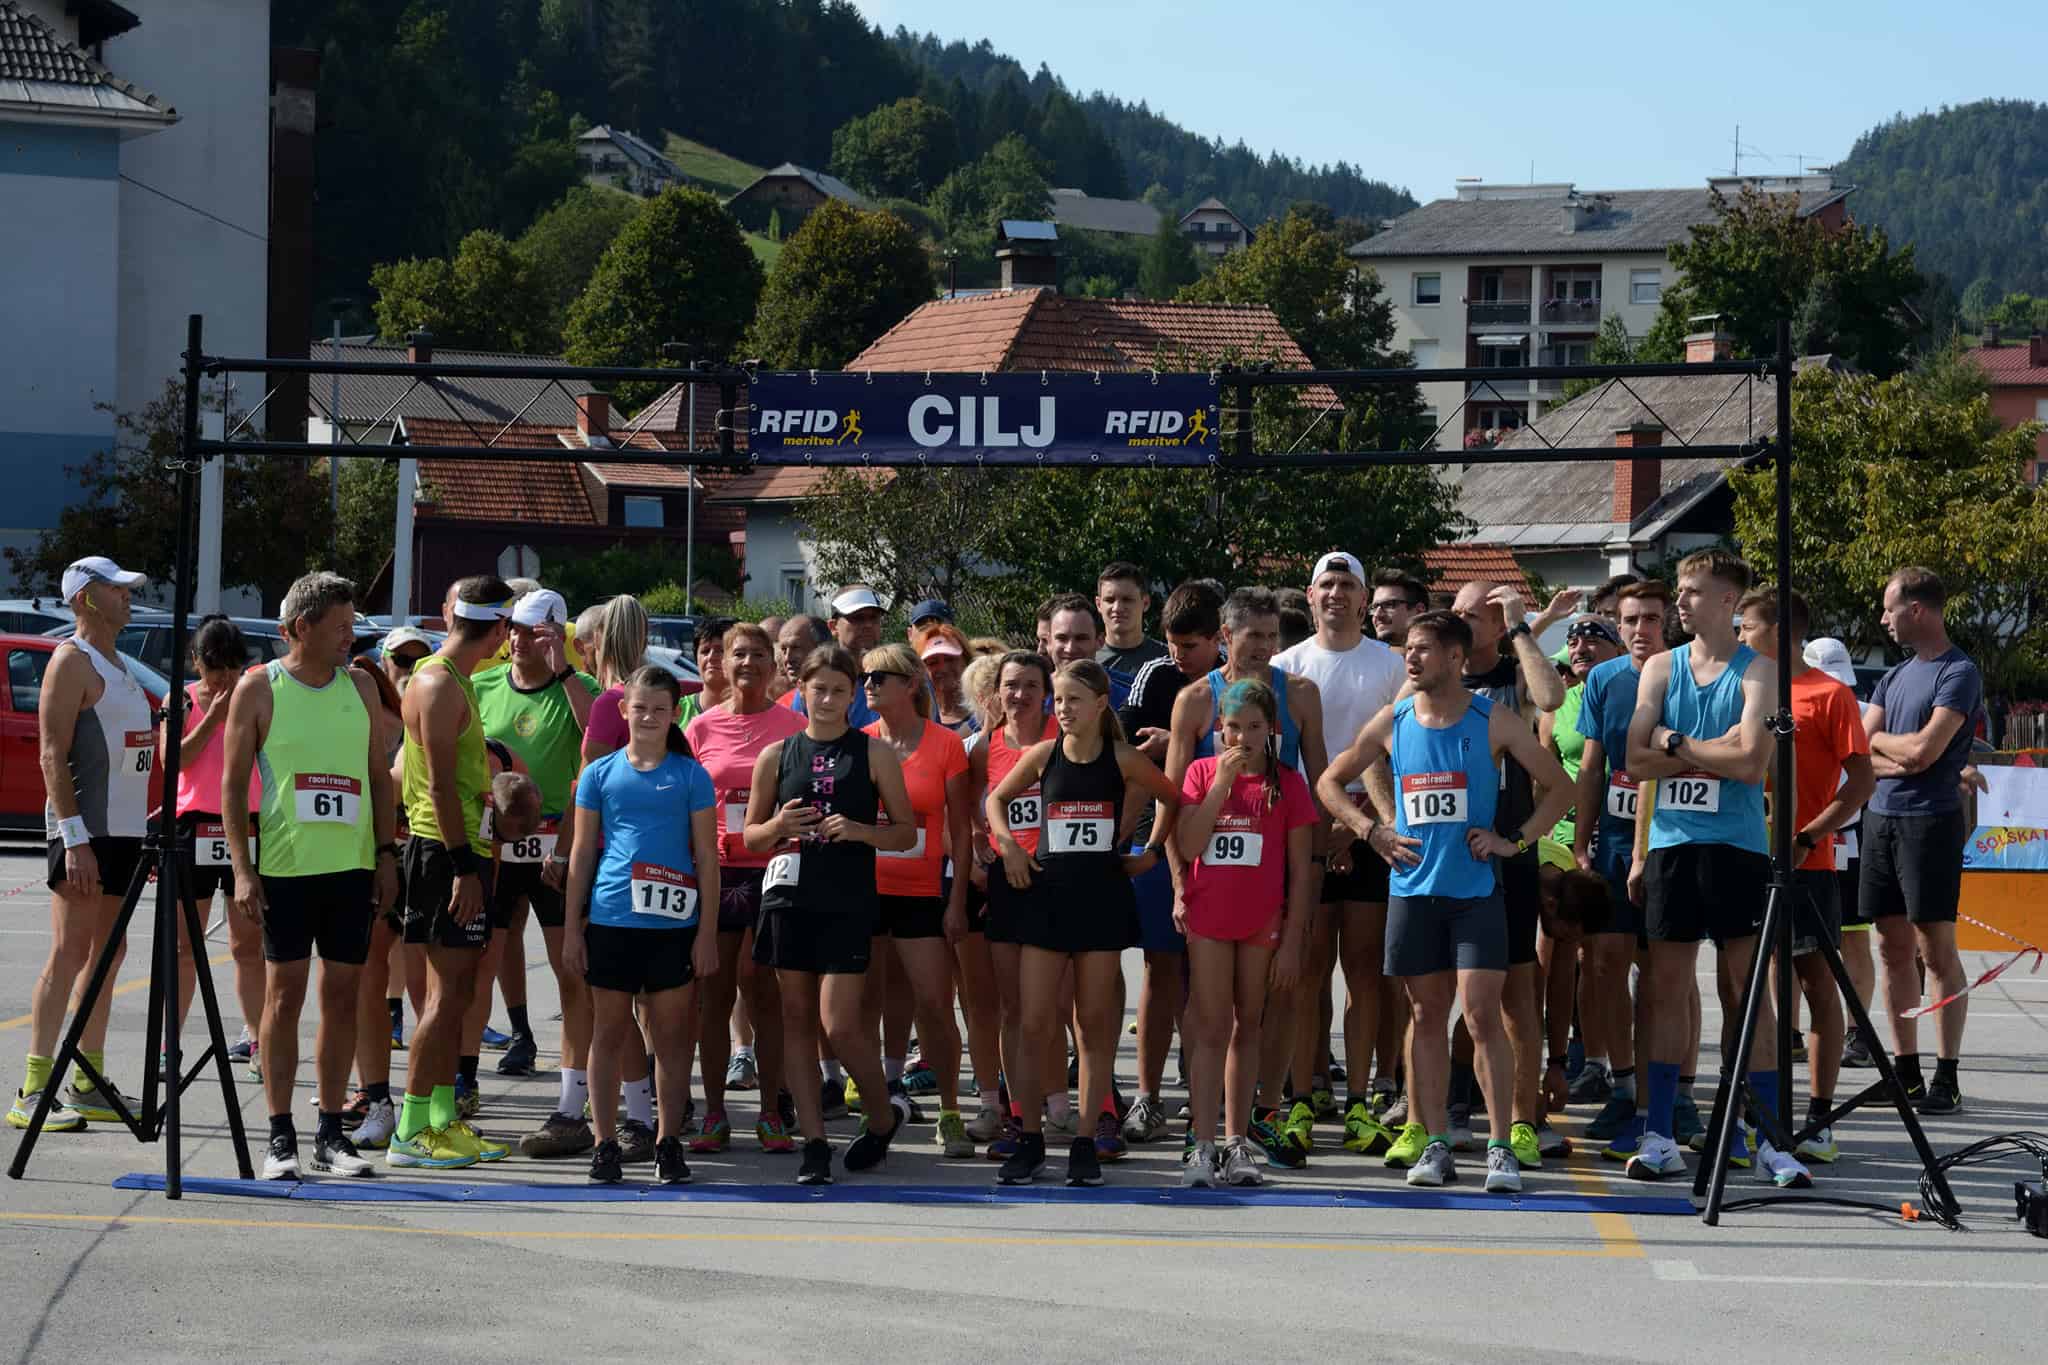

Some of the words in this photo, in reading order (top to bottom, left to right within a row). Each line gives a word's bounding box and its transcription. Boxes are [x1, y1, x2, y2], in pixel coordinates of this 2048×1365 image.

[760, 409, 838, 433] RFID
[908, 394, 1056, 447] CILJ
[1105, 410, 1183, 434] RFID
[783, 436, 834, 446] meritve
[1128, 436, 1181, 447] meritve
[314, 793, 343, 817] 61
[1411, 792, 1456, 818] 103
[1668, 781, 1708, 805] 102
[1010, 800, 1038, 824] 83
[1065, 822, 1098, 846] 75
[513, 837, 541, 858] 68
[1215, 836, 1244, 860] 99
[641, 884, 687, 913] 113
